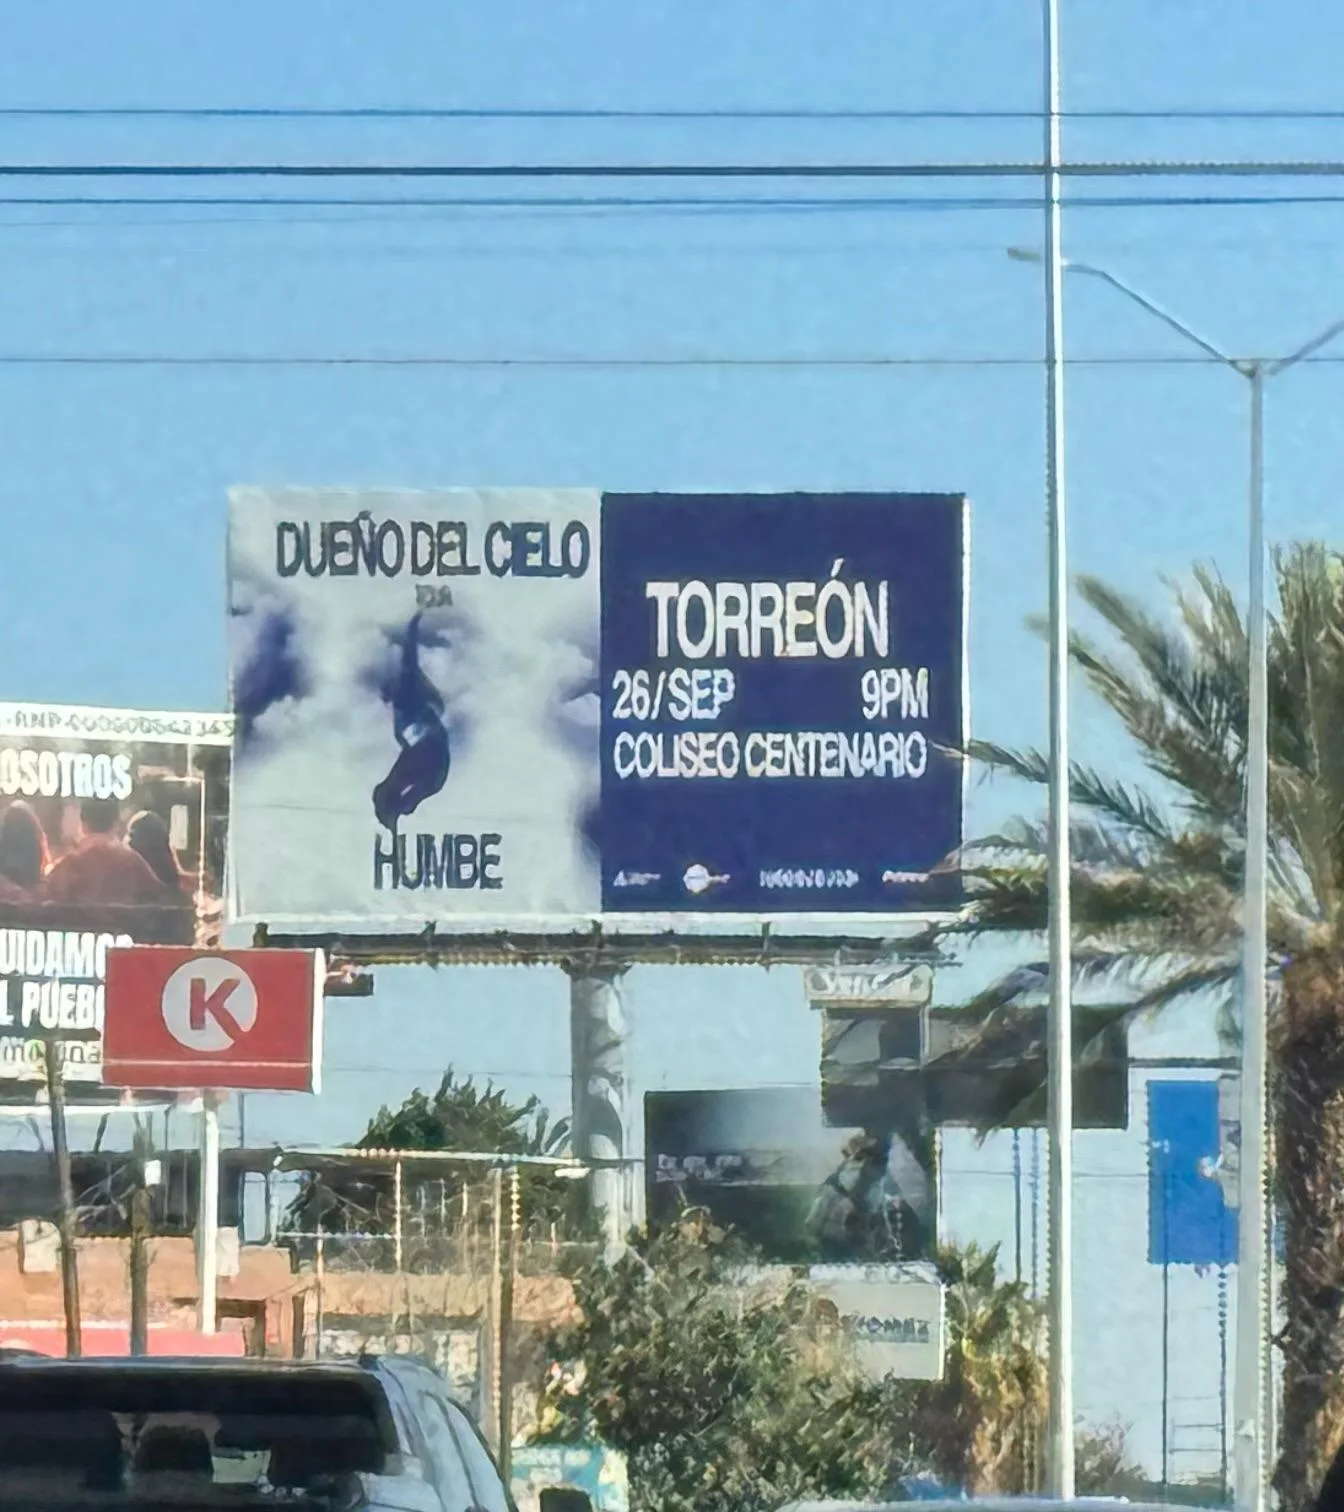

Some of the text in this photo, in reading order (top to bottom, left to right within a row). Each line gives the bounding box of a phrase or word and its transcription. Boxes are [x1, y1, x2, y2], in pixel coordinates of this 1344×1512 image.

[275, 510, 591, 578] DUEÑO DEL CIELO
[645, 557, 889, 659] TORREÓN
[611, 667, 929, 720] 26/SEP 9PM
[612, 731, 928, 779] COLISEO CENTENARIO
[373, 832, 504, 891] HUMBE
